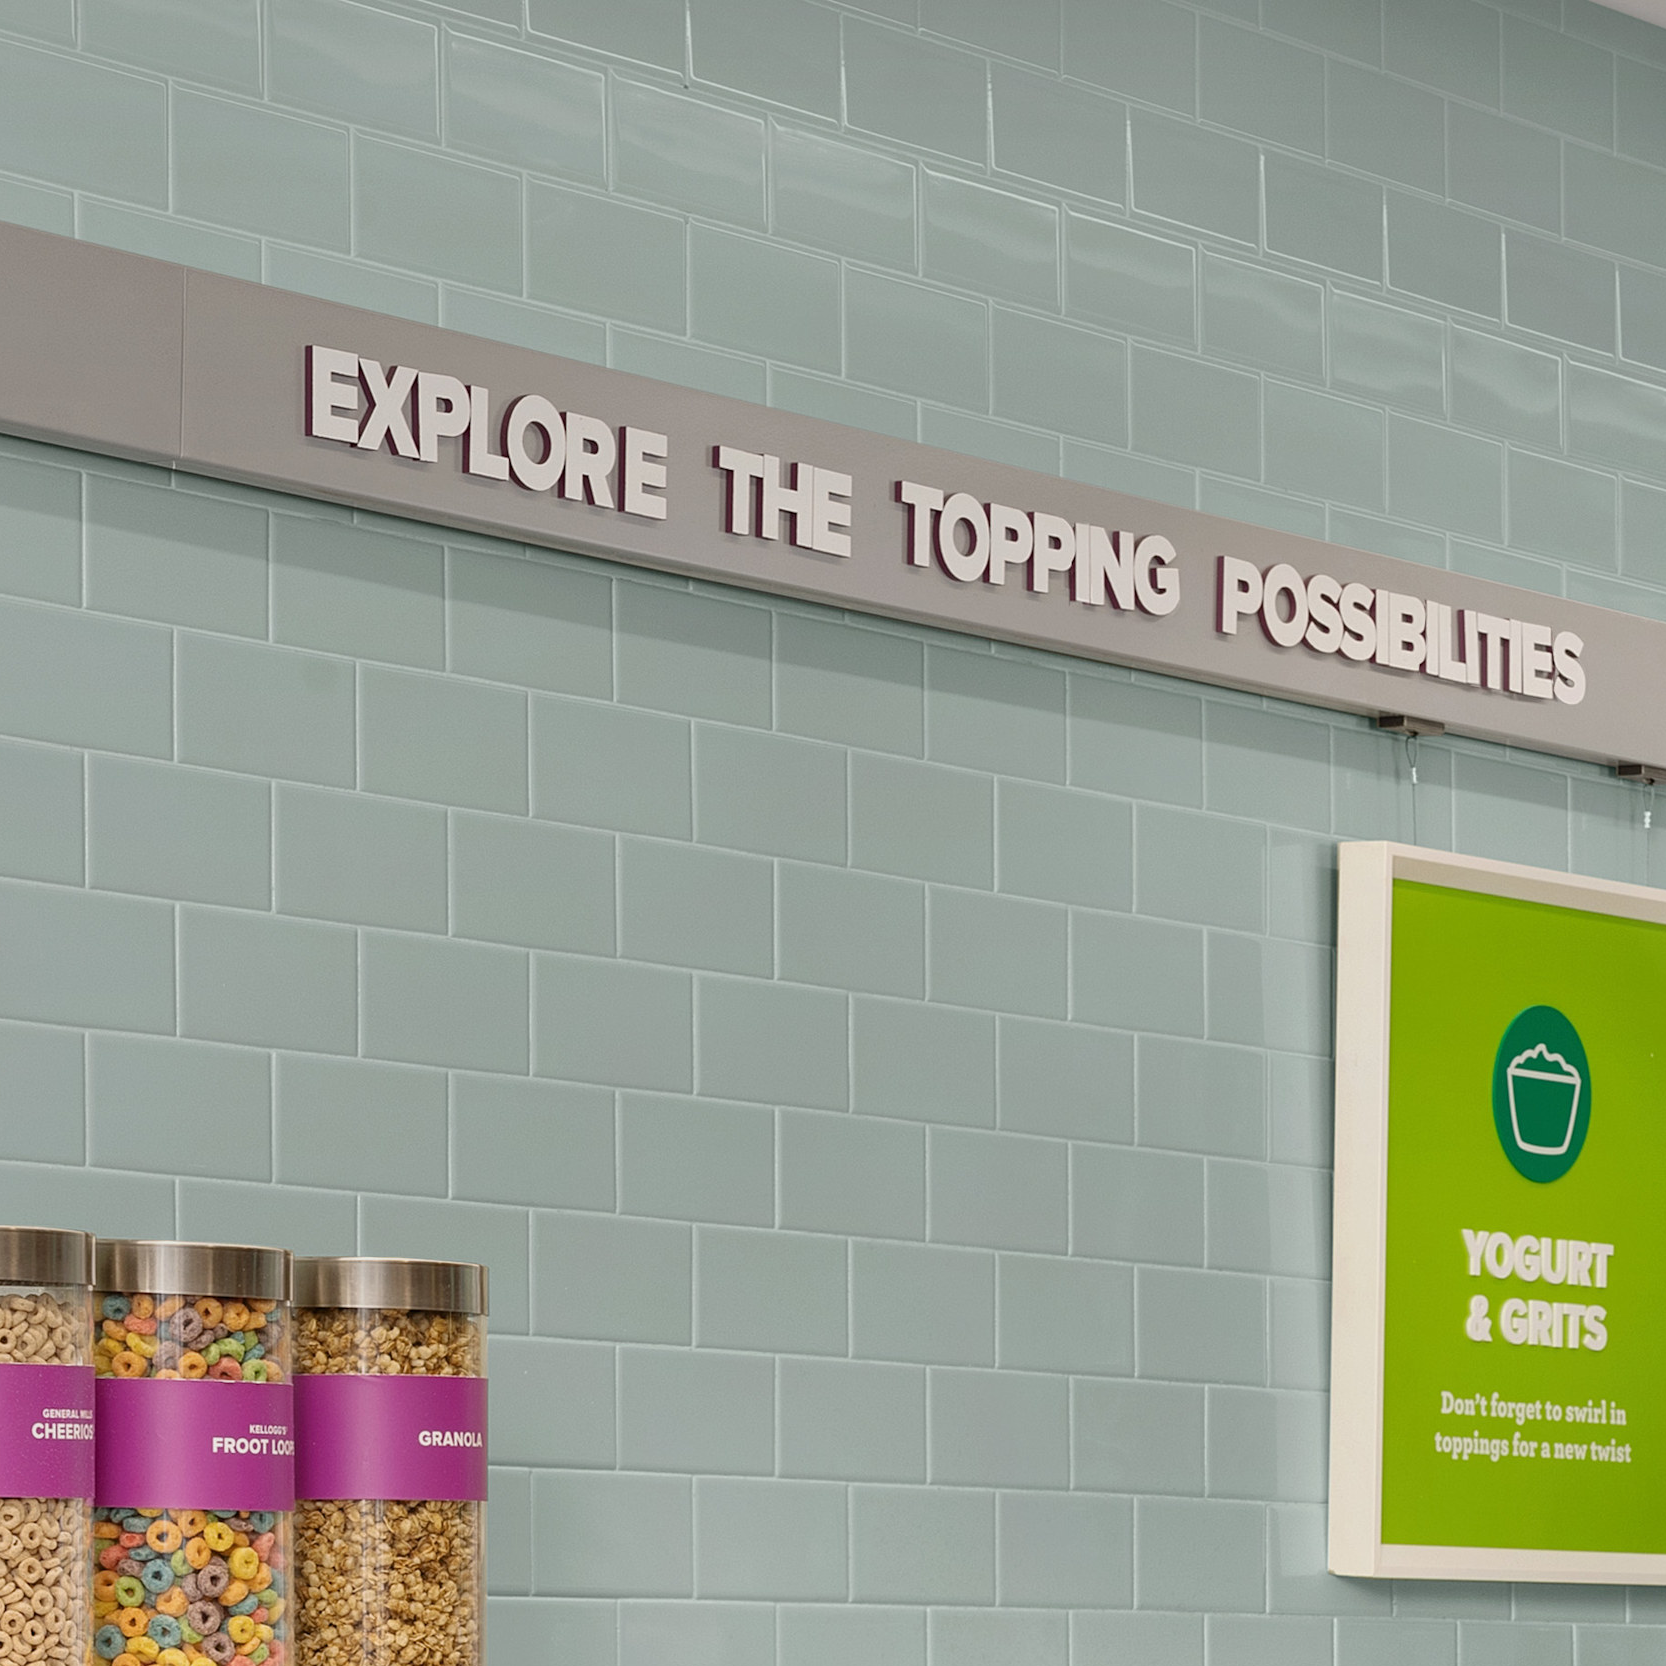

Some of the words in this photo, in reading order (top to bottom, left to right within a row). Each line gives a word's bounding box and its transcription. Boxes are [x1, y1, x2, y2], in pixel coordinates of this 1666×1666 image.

[304, 343, 669, 519] EXPLORE
[712, 445, 852, 558] THE
[893, 479, 1181, 616] TOPPING
[1214, 553, 1586, 705] POSSIBILITIES
[1461, 1228, 1614, 1289] YOGURT
[1465, 1294, 1493, 1343] &
[1500, 1297, 1608, 1351] GRITS
[42, 1408, 80, 1419] GENERAL
[1440, 1390, 1487, 1416] Don't
[1490, 1392, 1542, 1426] forget
[1545, 1399, 1563, 1422] to
[1565, 1399, 1607, 1424] swirl
[1609, 1401, 1627, 1426] in
[212, 1437, 269, 1454] FROOT
[271, 1439, 295, 1456] LOOP
[418, 1430, 483, 1448] GRANOLA
[1434, 1430, 1509, 1462] toppings
[1512, 1432, 1538, 1458] for
[1541, 1441, 1551, 1458] a
[1554, 1441, 1587, 1461] new
[1590, 1439, 1632, 1463] twist
